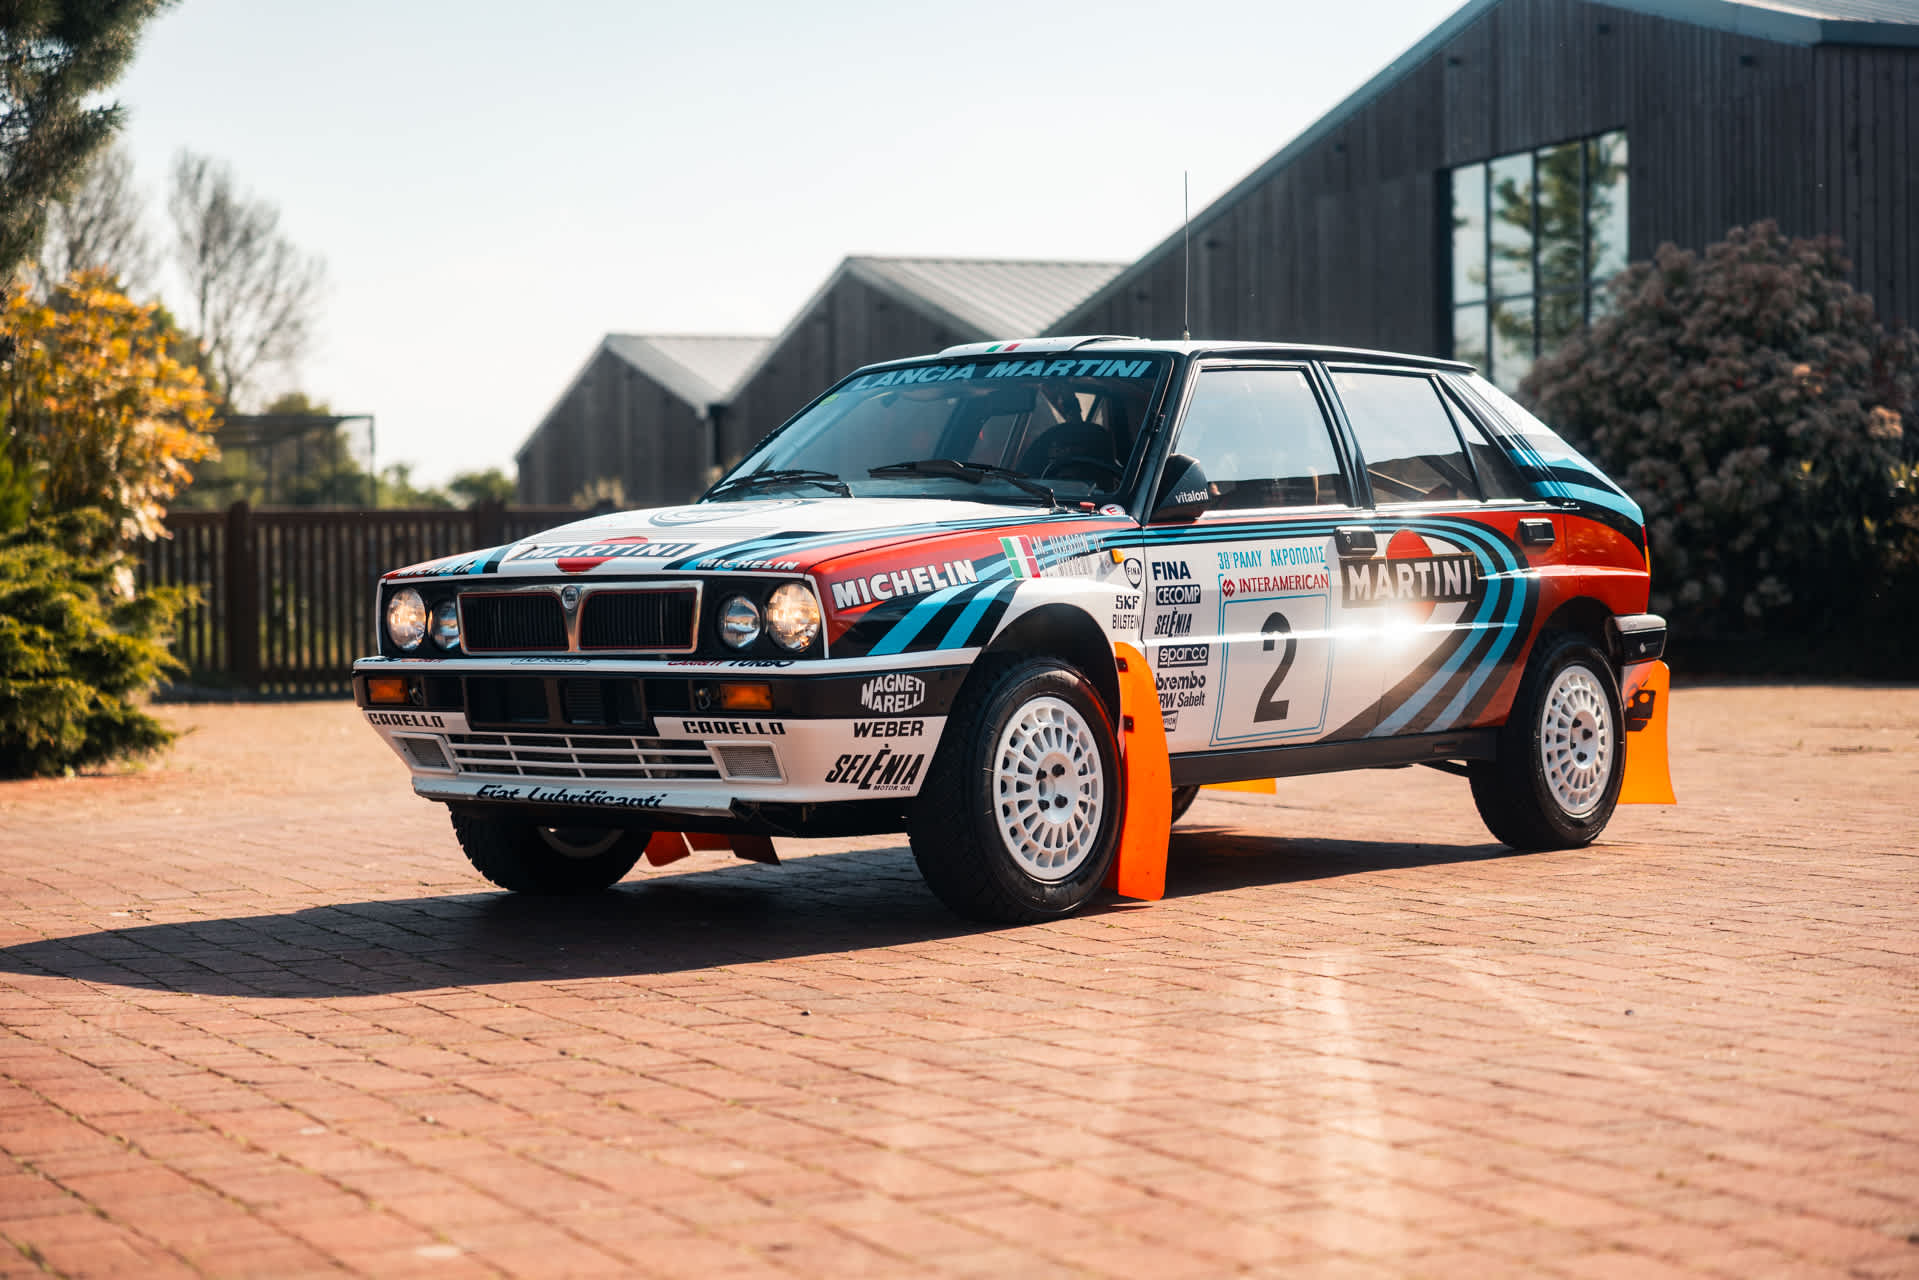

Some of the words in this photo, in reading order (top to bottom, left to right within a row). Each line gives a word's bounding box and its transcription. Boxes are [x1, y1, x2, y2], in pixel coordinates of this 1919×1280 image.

[852, 364, 977, 391] LANCIA
[987, 359, 1152, 378] MARTINI
[1175, 488, 1208, 503] vitaloni
[520, 543, 693, 559] MARTINI
[696, 558, 799, 570] MICHELIN
[1127, 567, 1140, 575] FINA
[1151, 561, 1192, 581] FINA
[830, 558, 979, 609] MICHELIN
[1239, 574, 1329, 593] INTERAMERICAN
[1347, 559, 1472, 602] MARTINI
[1115, 595, 1140, 610] SKF
[1157, 586, 1200, 604] CECOMP
[1159, 647, 1208, 667] sparco
[1253, 611, 1297, 723] 2
[1156, 671, 1206, 691] brembo
[1177, 690, 1205, 708] Sabelt
[368, 713, 445, 728] CARELLO
[682, 721, 786, 735] CARELLO
[854, 721, 924, 738] WEBER
[477, 784, 520, 800] Fiat
[528, 787, 667, 808] Lubrificanti
